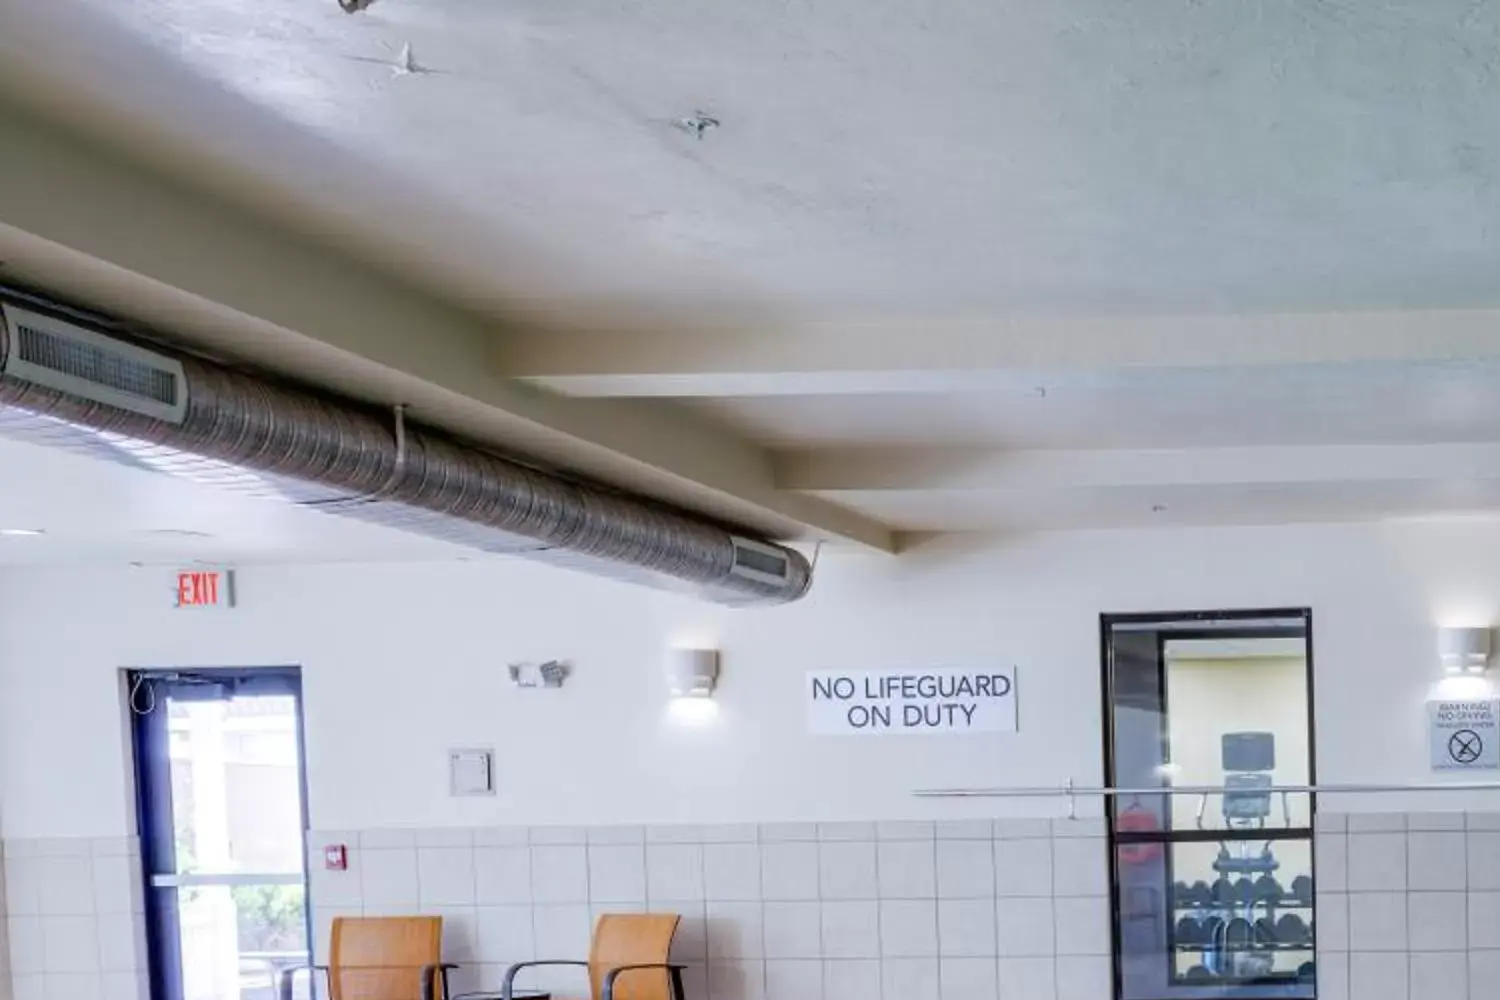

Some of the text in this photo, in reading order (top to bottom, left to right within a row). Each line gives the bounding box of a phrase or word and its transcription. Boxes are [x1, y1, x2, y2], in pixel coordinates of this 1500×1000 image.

[178, 573, 219, 607] EXIT
[812, 675, 1011, 700] NO LIFEGUARD
[847, 703, 977, 728] ON DUTY
